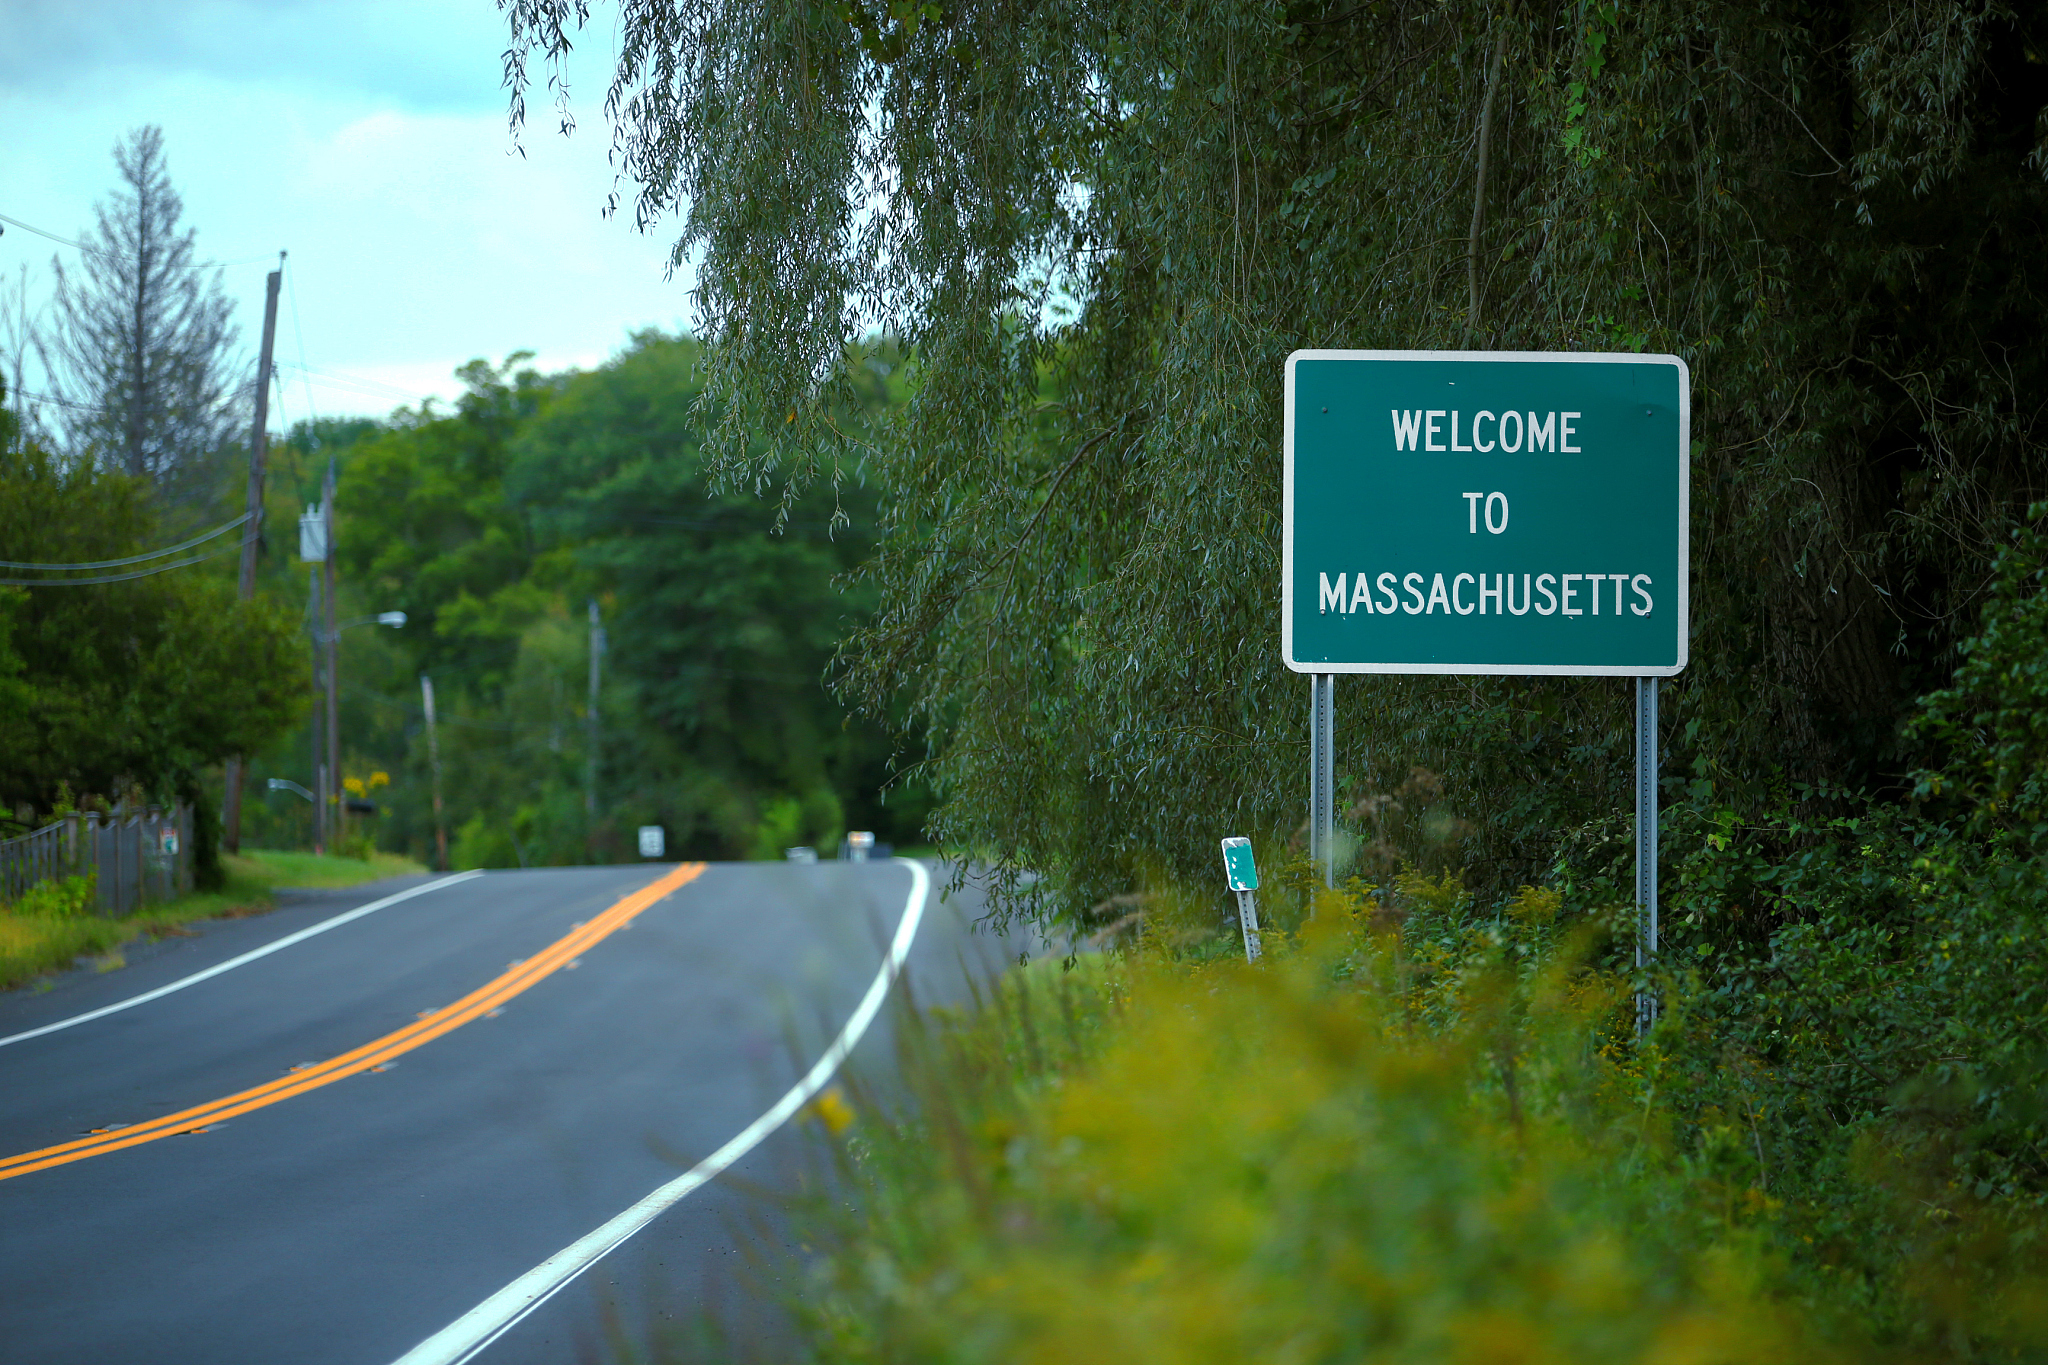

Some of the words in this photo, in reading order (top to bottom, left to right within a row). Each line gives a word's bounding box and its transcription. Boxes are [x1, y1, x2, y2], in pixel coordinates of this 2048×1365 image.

[1391, 409, 1582, 453] WELCOME
[1462, 491, 1509, 535] TO
[1318, 572, 1654, 616] MASSACHUSETTS
